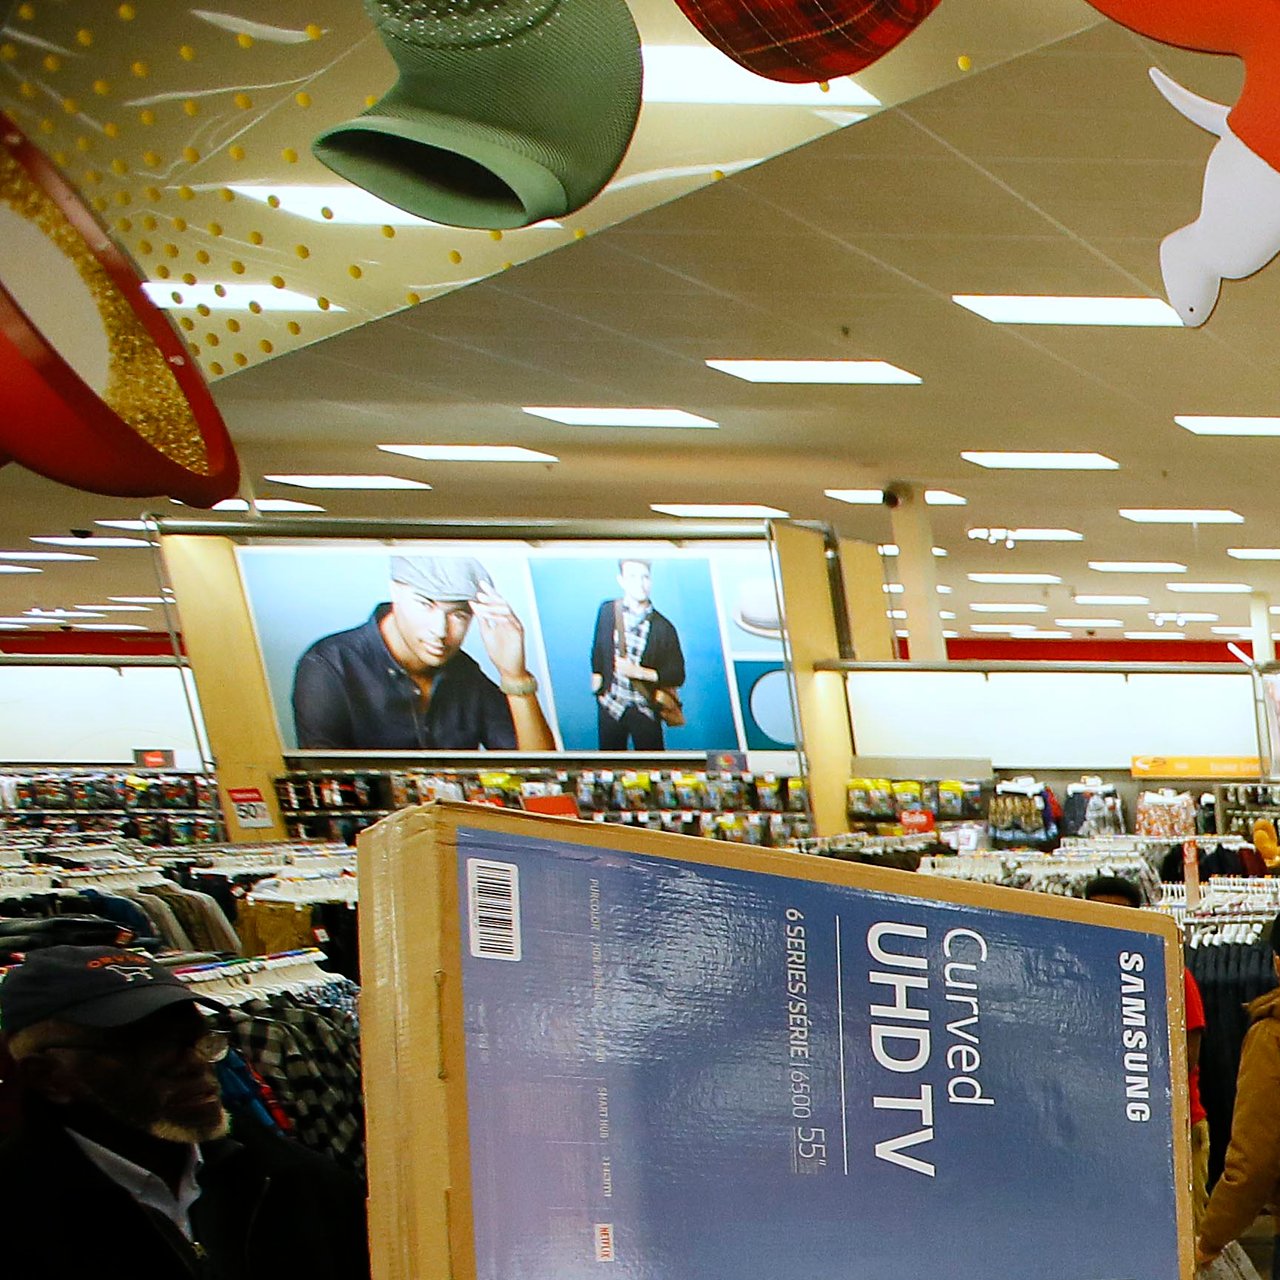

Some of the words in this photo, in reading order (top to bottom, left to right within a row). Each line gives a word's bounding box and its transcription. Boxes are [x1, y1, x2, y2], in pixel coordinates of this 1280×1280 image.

[588, 878, 601, 931] PURCOLOR
[785, 908, 805, 920] 6
[785, 925, 810, 1060] SERIES/SÉRIE
[867, 921, 932, 1074] UHD
[942, 928, 996, 1106] Curved
[1118, 951, 1152, 1123] SAMSUNG
[598, 1087, 609, 1117] SMART
[791, 1071, 812, 1120] 6500
[599, 1119, 610, 1140] HUB
[872, 1084, 936, 1178] TV
[600, 1227, 611, 1258] NETFLIX
